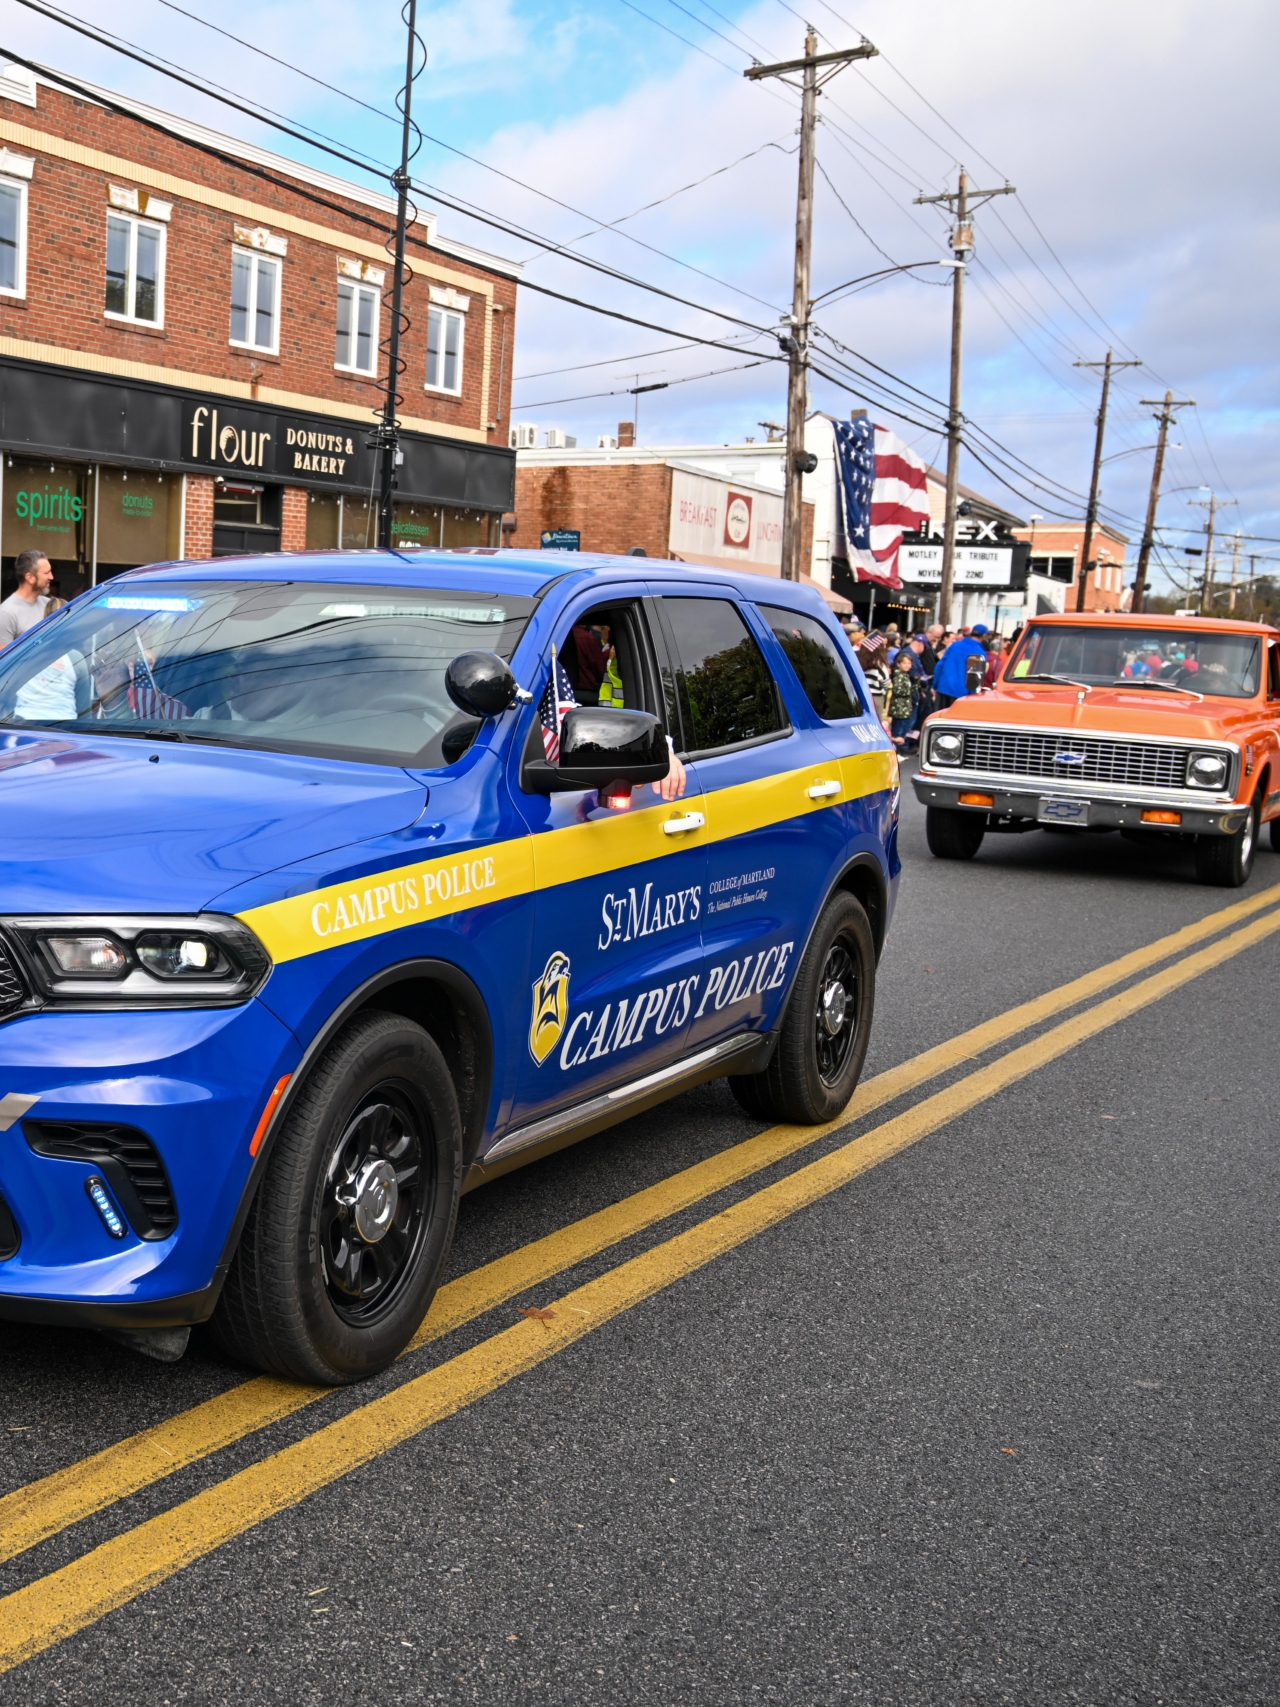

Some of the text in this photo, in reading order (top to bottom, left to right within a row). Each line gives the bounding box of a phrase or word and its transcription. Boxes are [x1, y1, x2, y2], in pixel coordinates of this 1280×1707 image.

[190, 407, 271, 467] flour
[286, 428, 354, 455] DONUTS &
[293, 452, 346, 475] BAKERY
[16, 485, 82, 526] spirits
[122, 492, 153, 509] donuts
[680, 500, 717, 528] BREAKFAST
[928, 520, 998, 540] REX
[908, 550, 938, 559] MOTLEY
[969, 552, 998, 560] TRIBUTE
[965, 571, 984, 579] 22ND
[709, 876, 738, 895] COLLEGE
[741, 867, 775, 886] MARYLAND
[311, 857, 496, 937] CAMPUS POLICE
[560, 941, 794, 1071] CAMPUS POLICE
